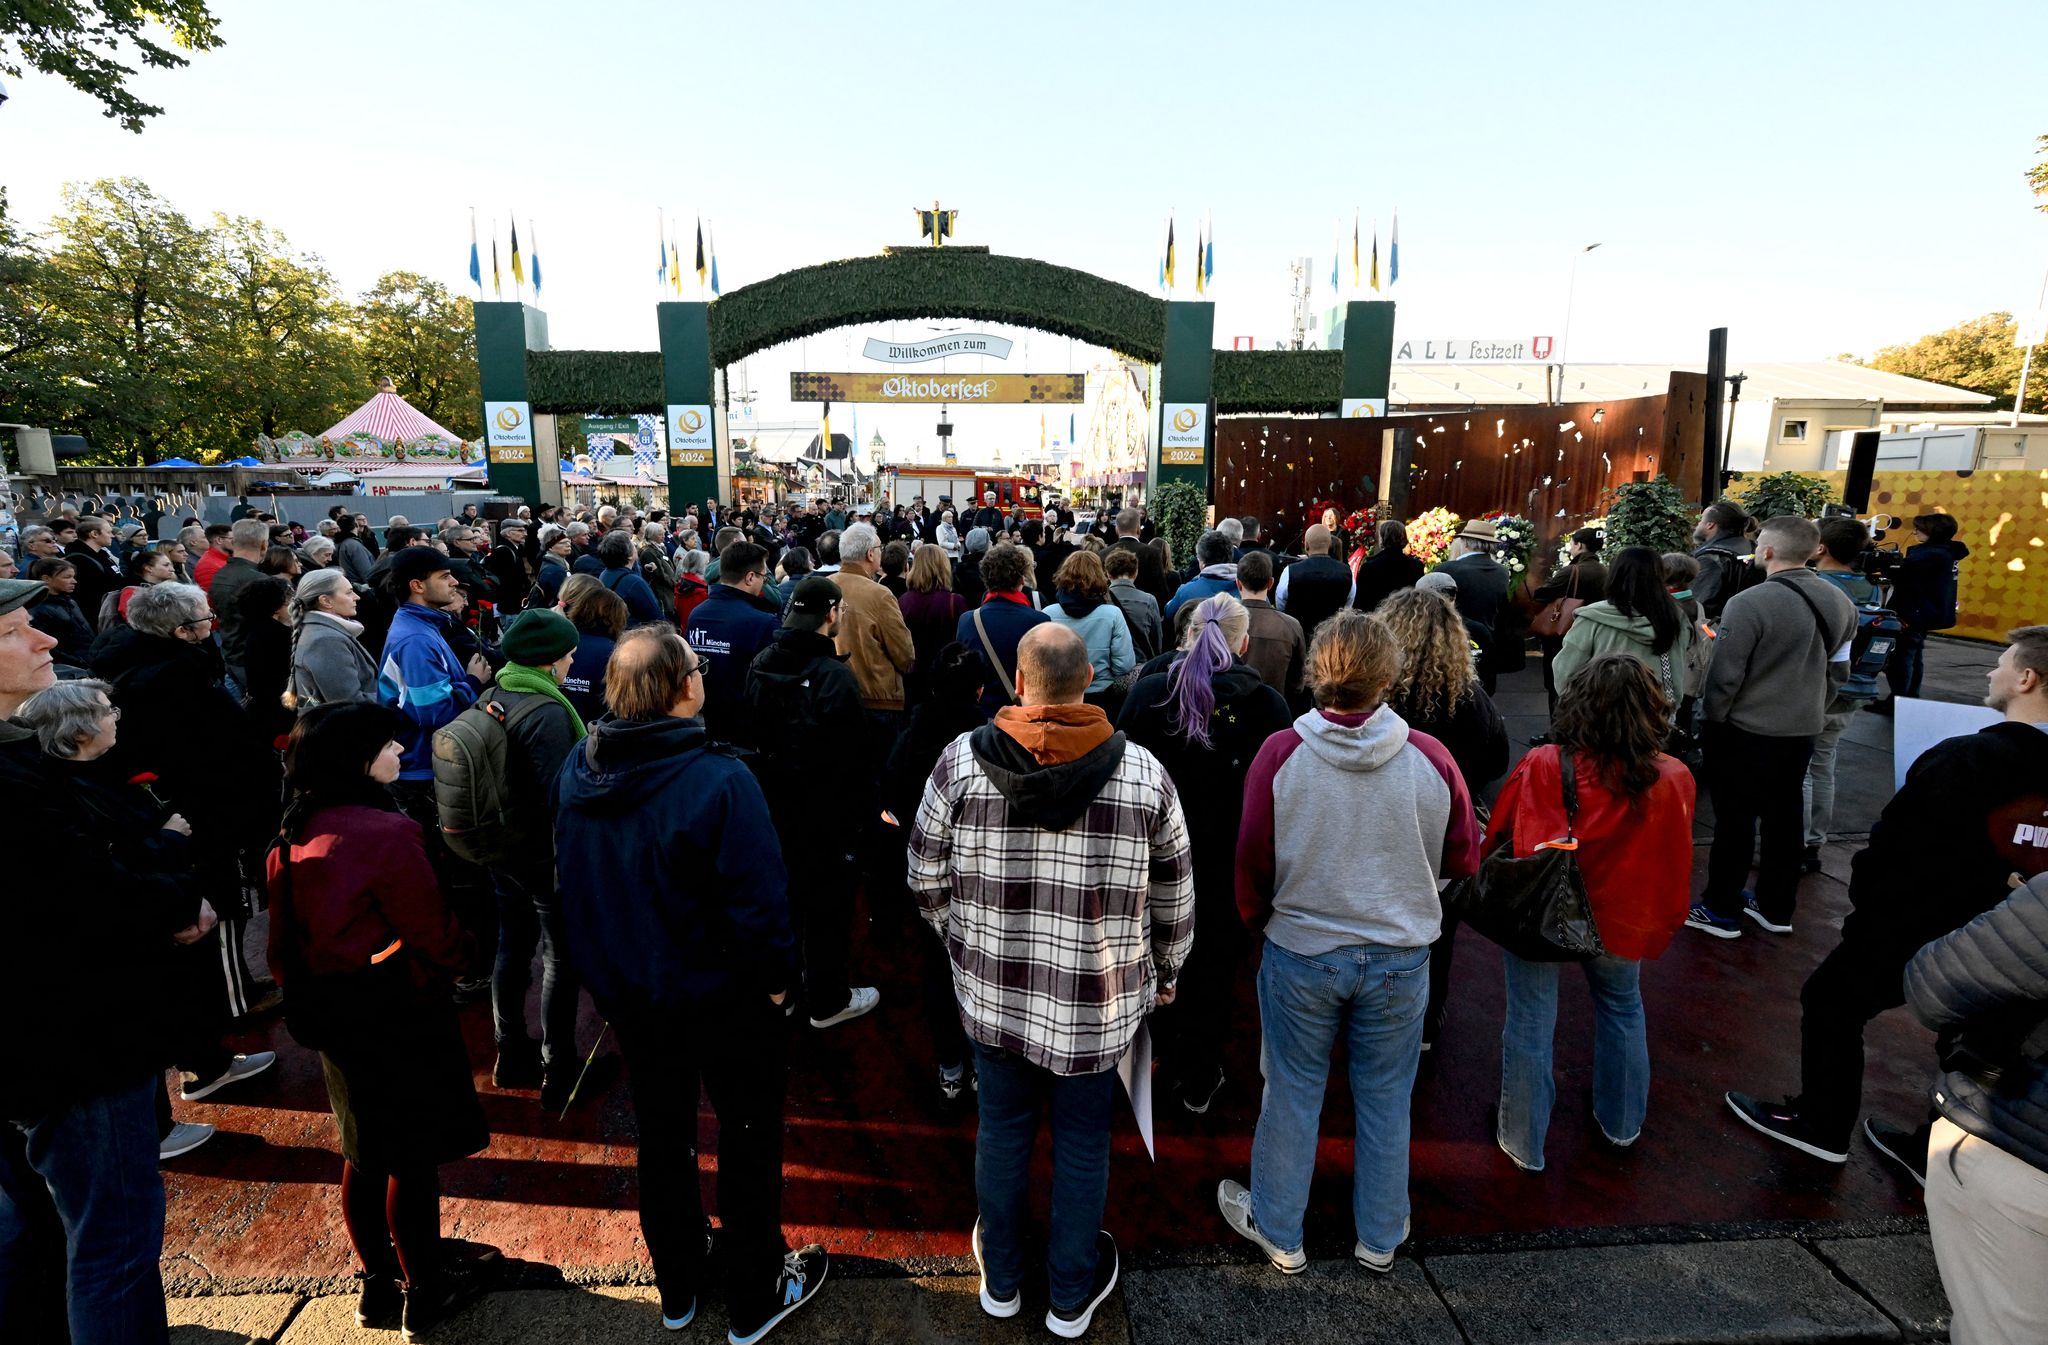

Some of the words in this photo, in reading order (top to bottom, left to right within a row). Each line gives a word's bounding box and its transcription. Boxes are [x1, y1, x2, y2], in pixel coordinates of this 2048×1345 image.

[889, 341, 960, 359] Willkommen
[964, 340, 986, 350] zum
[1469, 340, 1524, 359] festzelt
[880, 376, 997, 400] Oktoberfest
[494, 433, 526, 441] Oktoberfest
[499, 450, 525, 460] 2026
[680, 452, 705, 462] 2026
[1170, 451, 1196, 461] 2026
[706, 639, 730, 648] München
[783, 1276, 804, 1306] N
